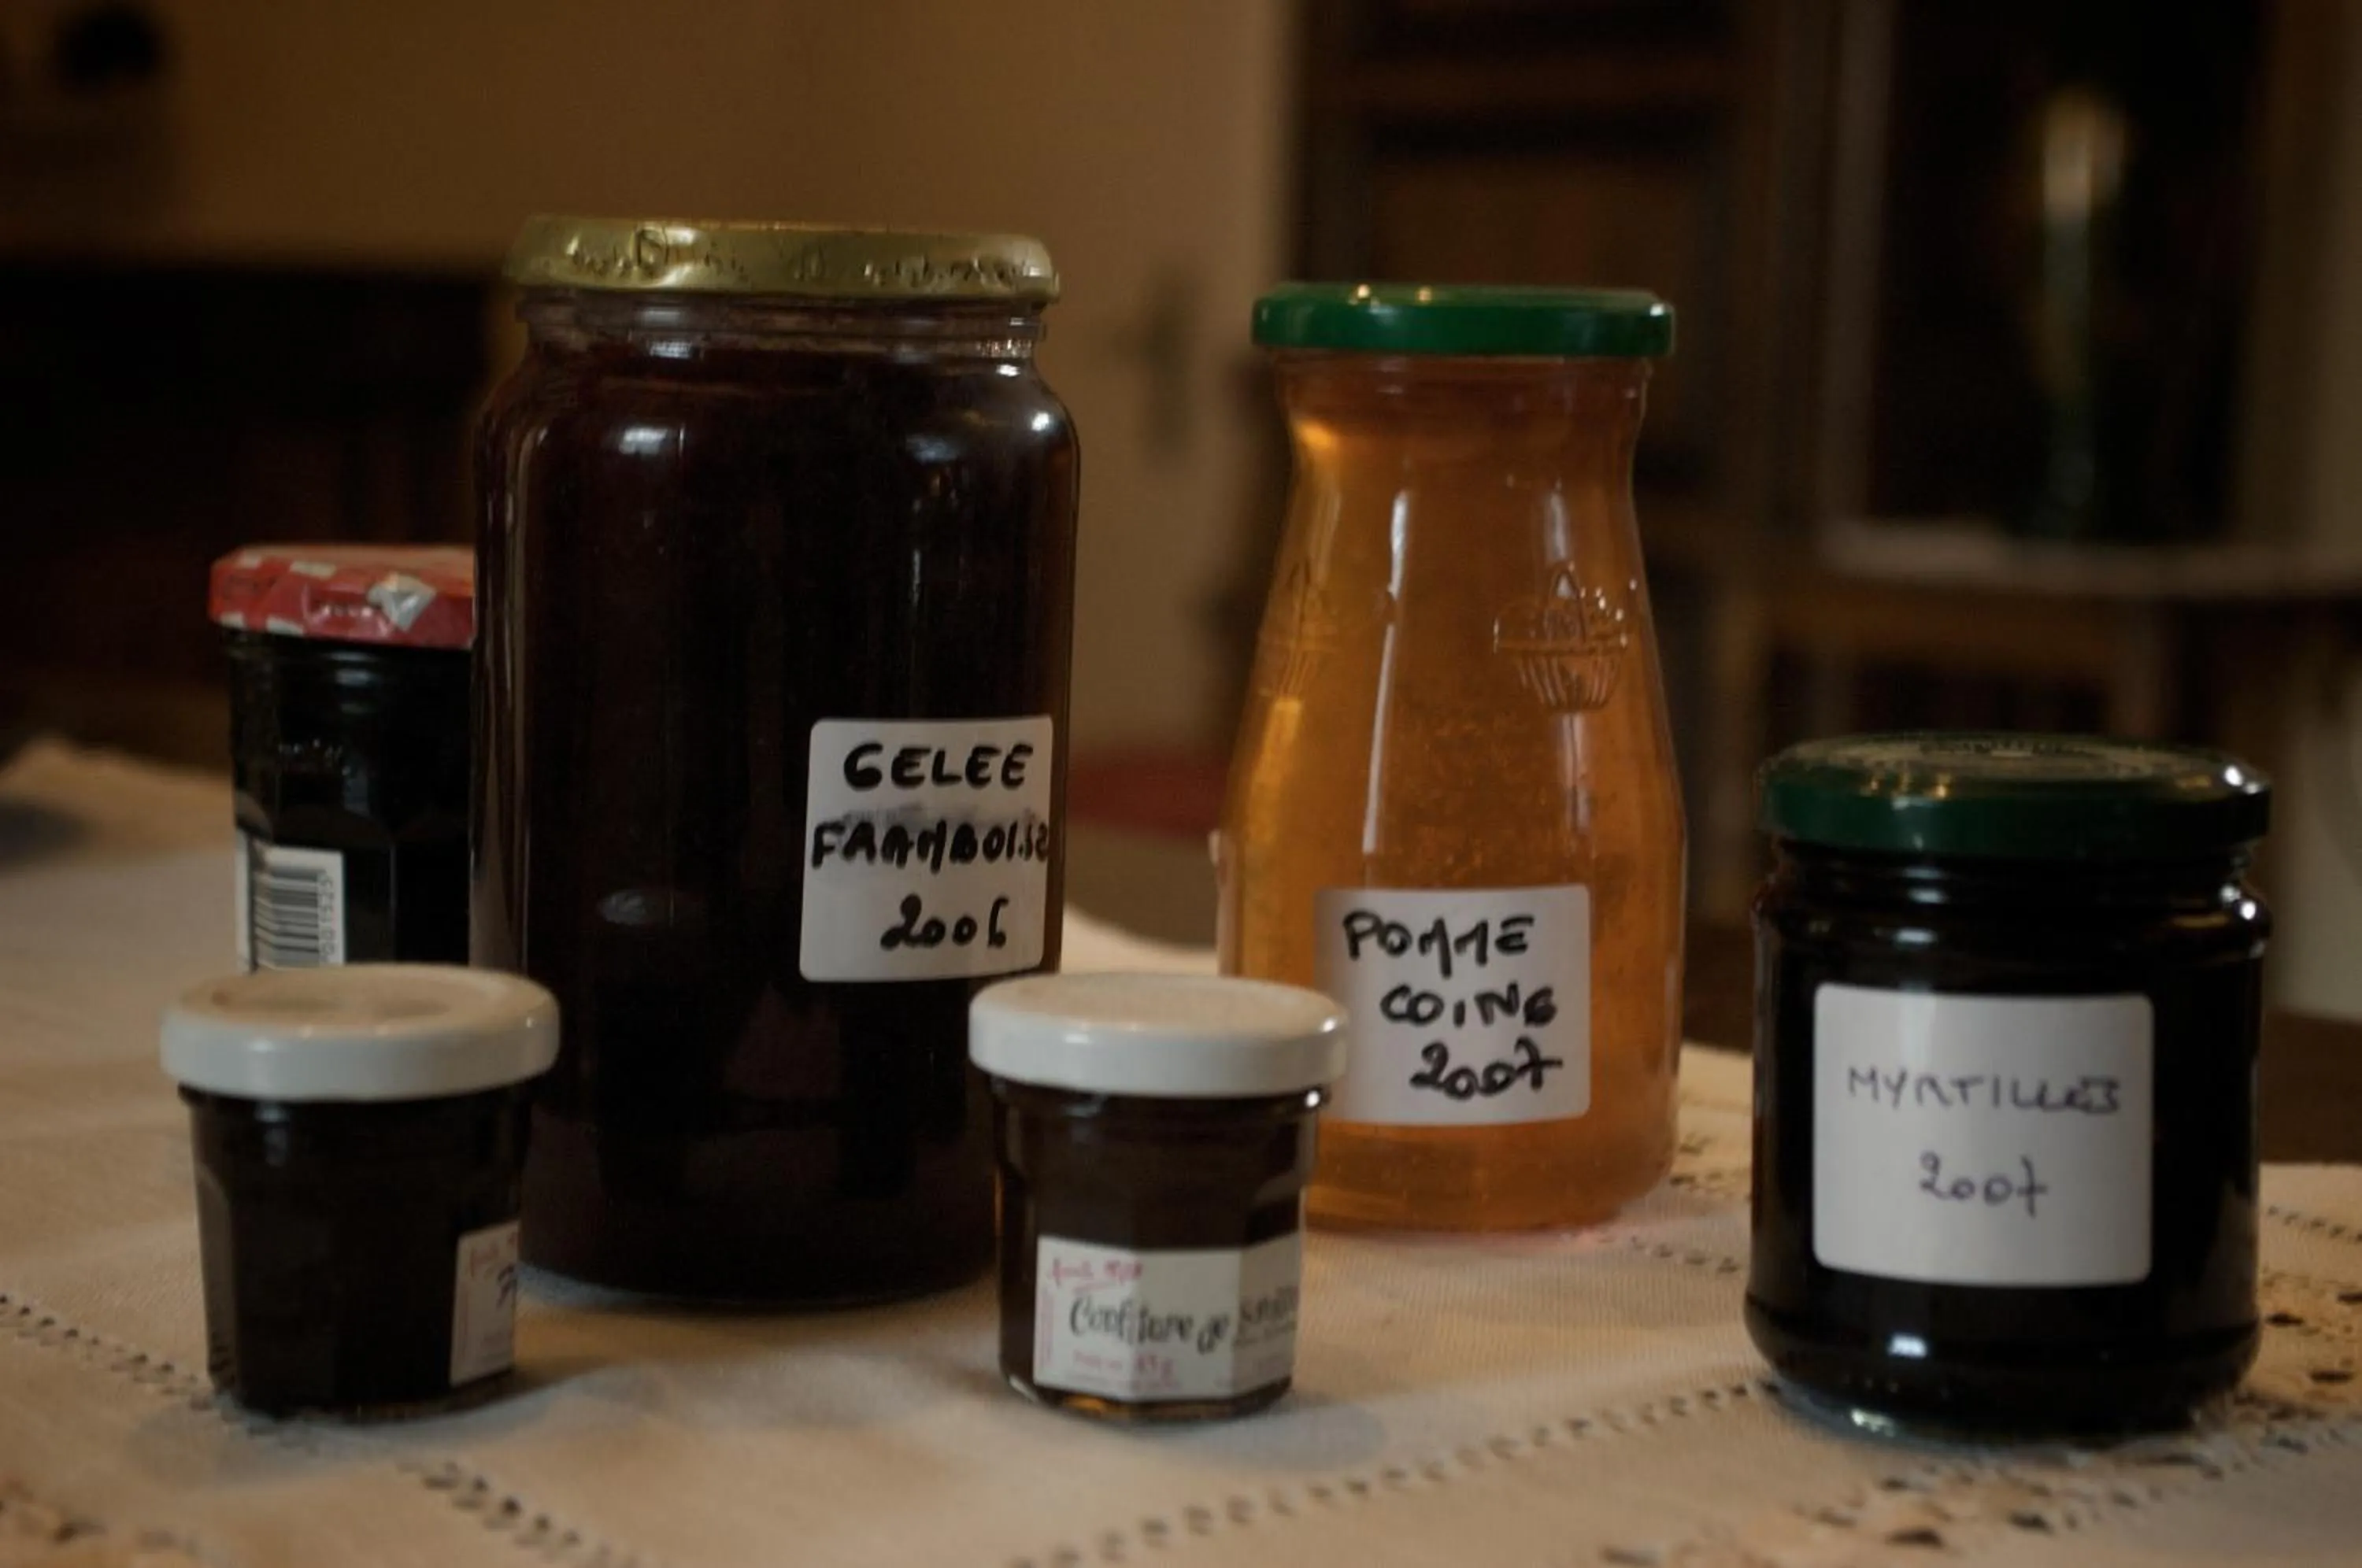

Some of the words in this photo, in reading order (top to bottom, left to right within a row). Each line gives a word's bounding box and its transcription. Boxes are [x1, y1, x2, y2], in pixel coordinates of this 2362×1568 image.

[843, 743, 1034, 790] GELEE
[879, 893, 1009, 949] 2006
[1343, 910, 1535, 978] POMME
[1380, 982, 1557, 1028] COING
[1409, 1037, 1564, 1099] 2007
[1919, 1152, 2048, 1218] 2007
